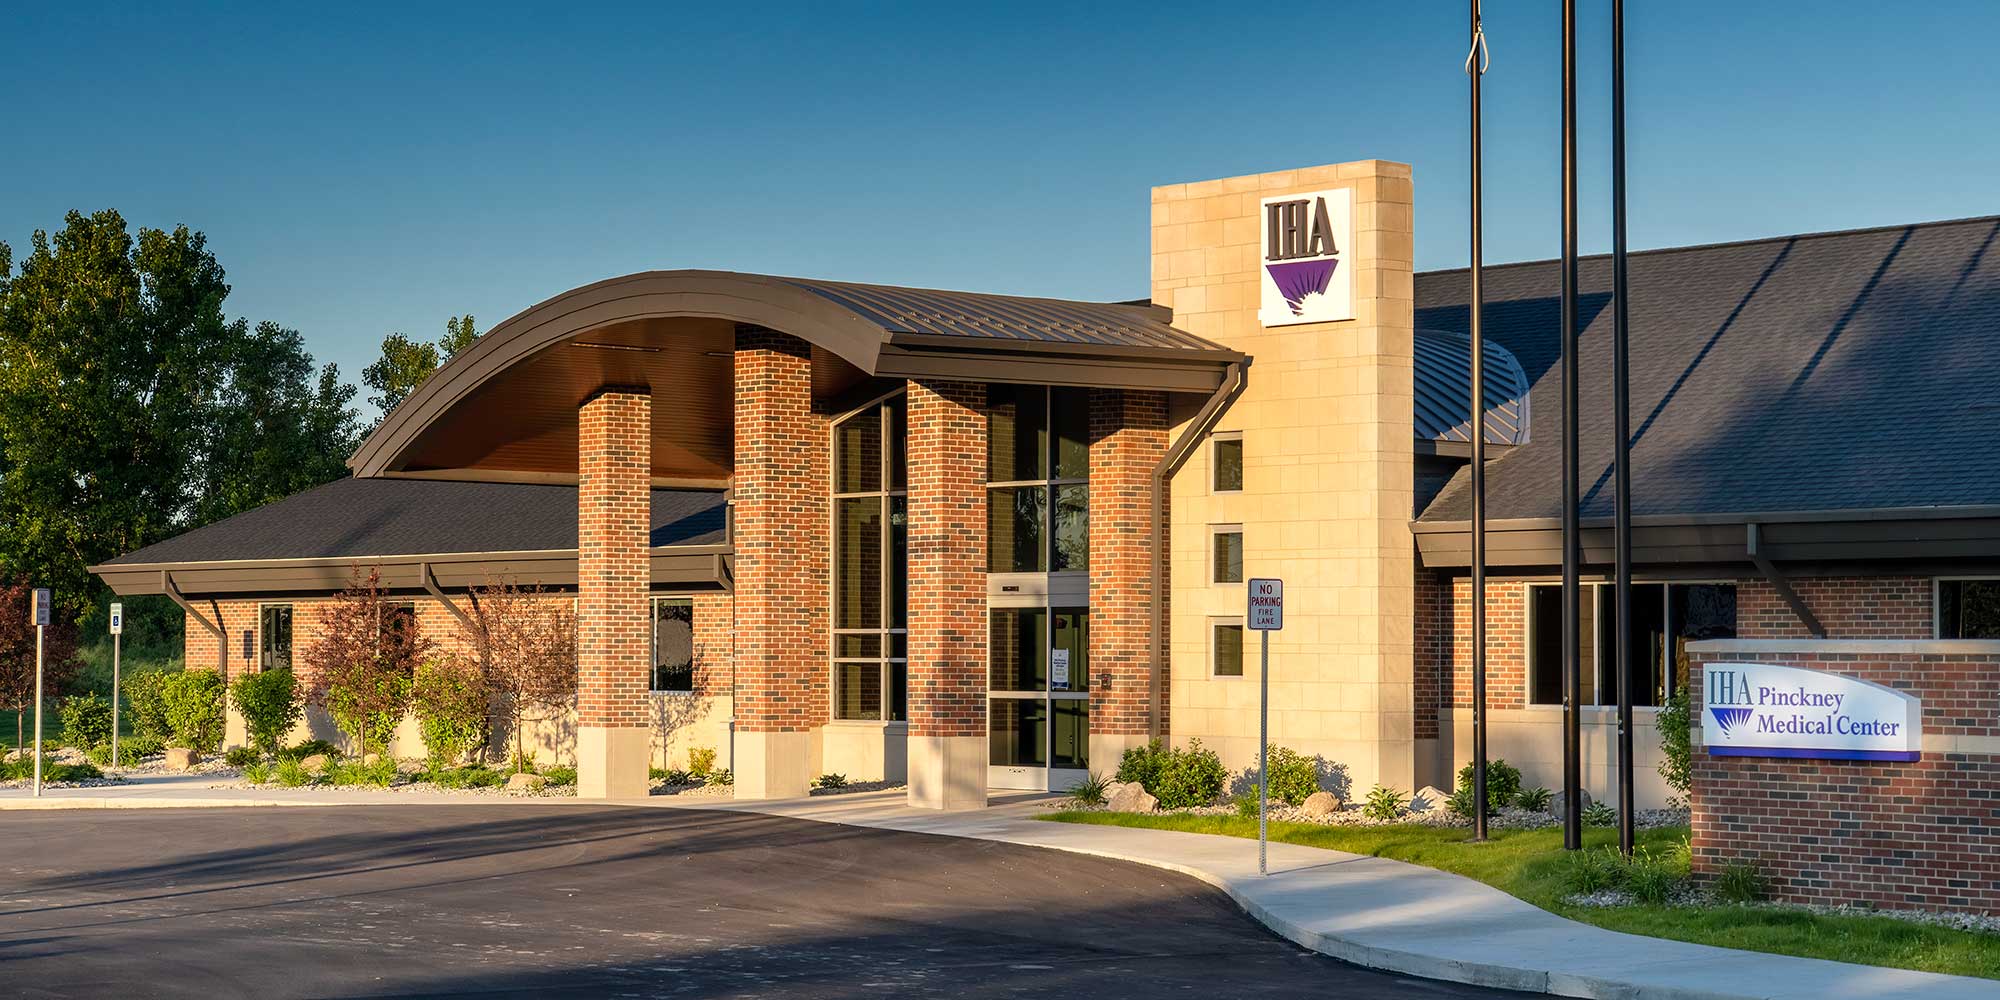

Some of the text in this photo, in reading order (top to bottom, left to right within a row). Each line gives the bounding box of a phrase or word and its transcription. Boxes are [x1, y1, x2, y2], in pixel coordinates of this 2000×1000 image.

[1265, 197, 1339, 261] IHA
[1251, 596, 1280, 606] PARKING
[1260, 584, 1272, 595] NO
[1709, 671, 1753, 705] IHA
[1758, 687, 1844, 714] Pinckney
[1757, 714, 1900, 737] Medical Center
